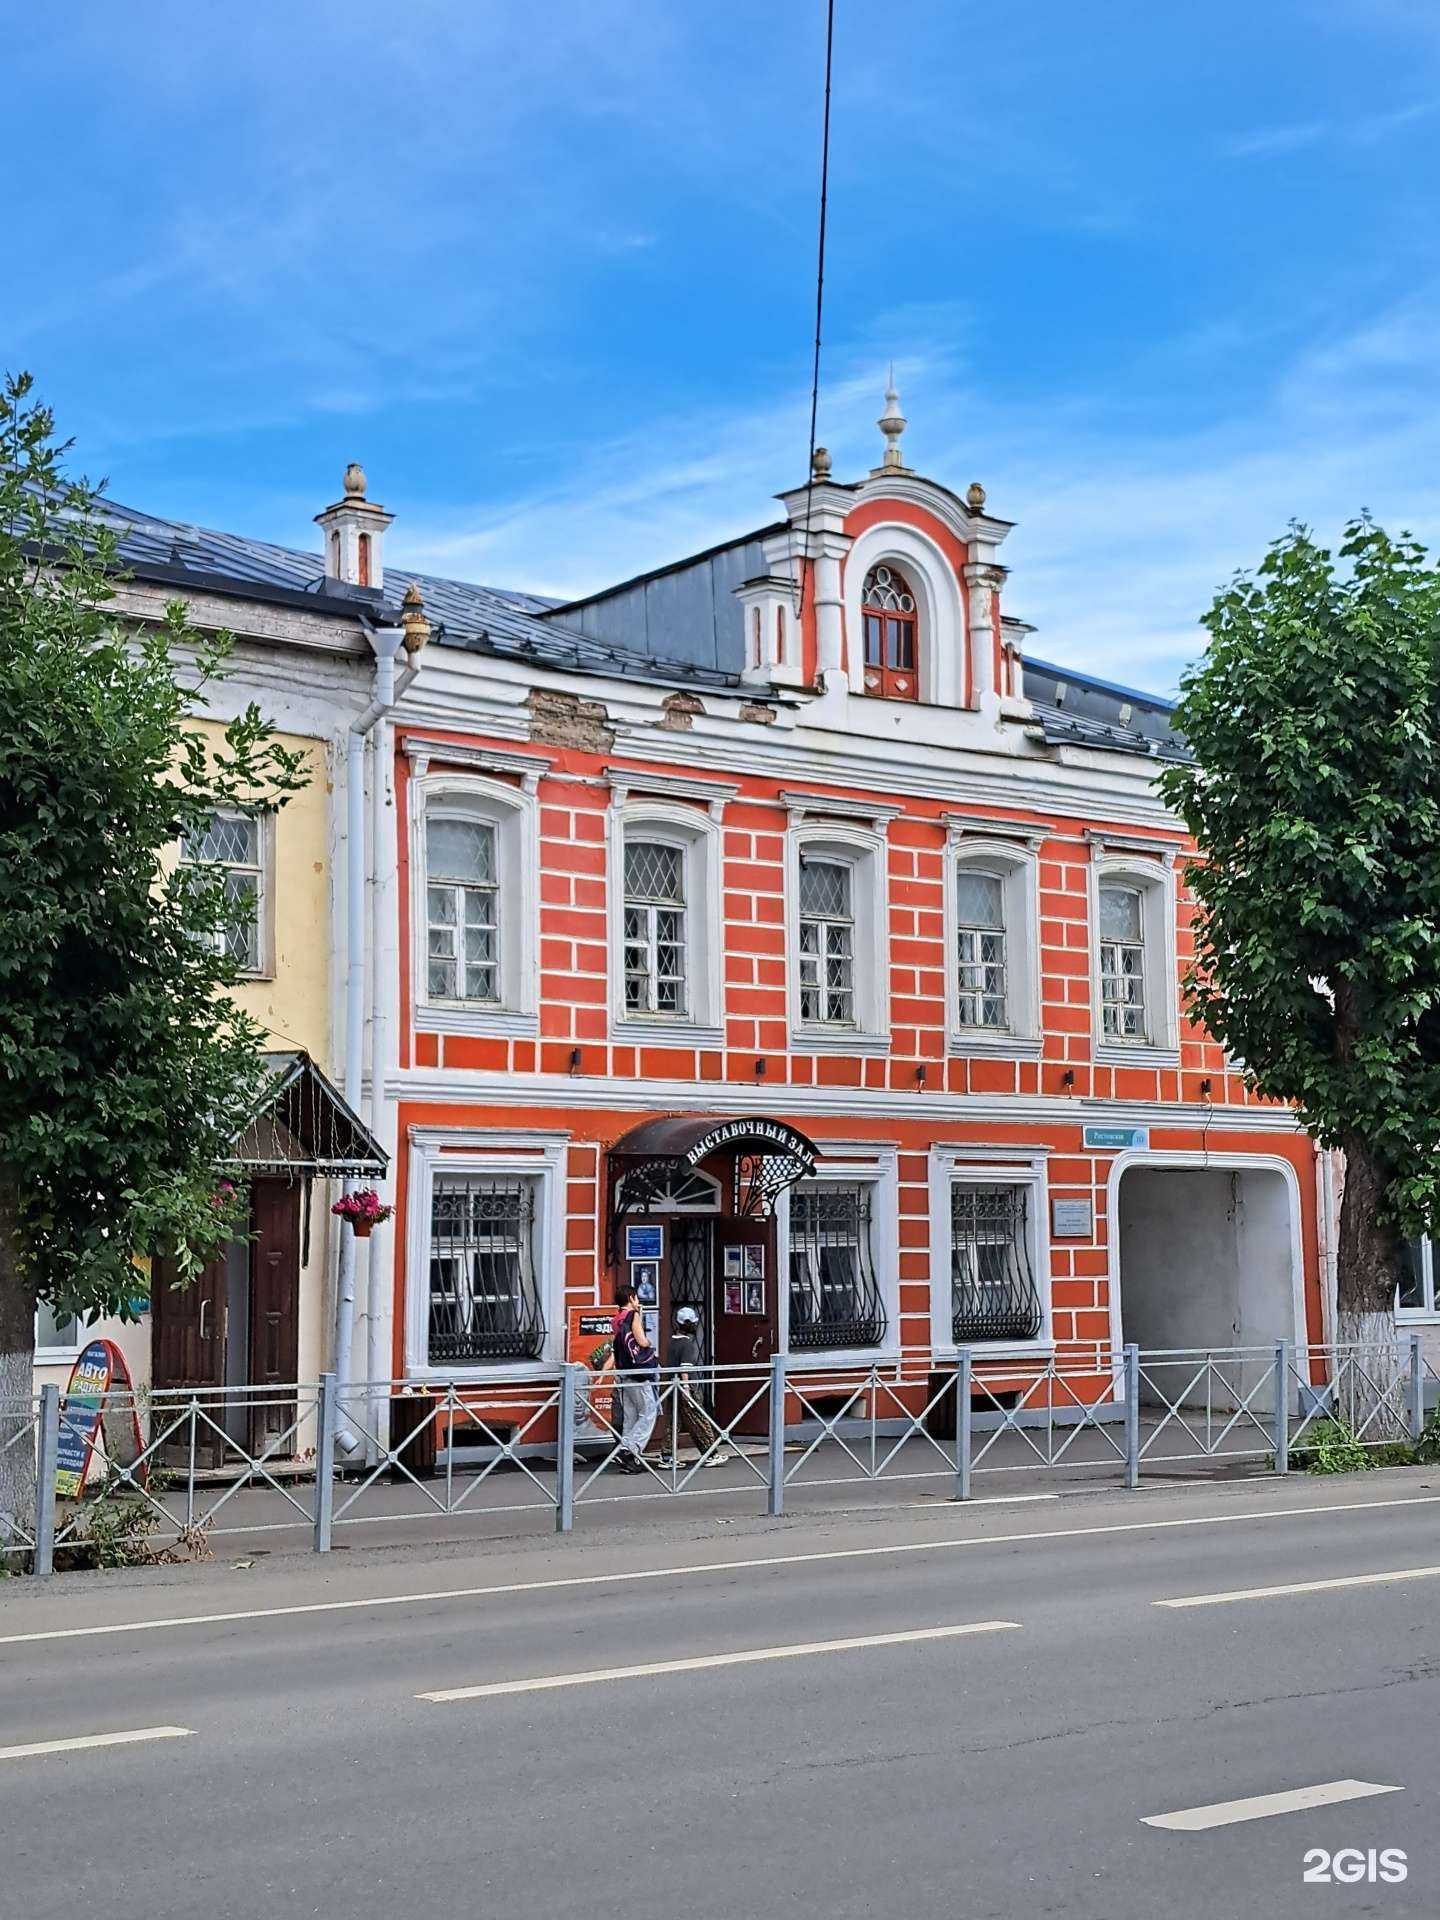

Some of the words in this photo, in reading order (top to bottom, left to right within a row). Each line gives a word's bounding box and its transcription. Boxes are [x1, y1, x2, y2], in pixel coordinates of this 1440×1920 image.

[686, 1121, 787, 1165] ВЫСТАВОЧНЫЙ
[787, 1137, 815, 1165] ЗАЛ
[77, 1362, 109, 1380] АВТО
